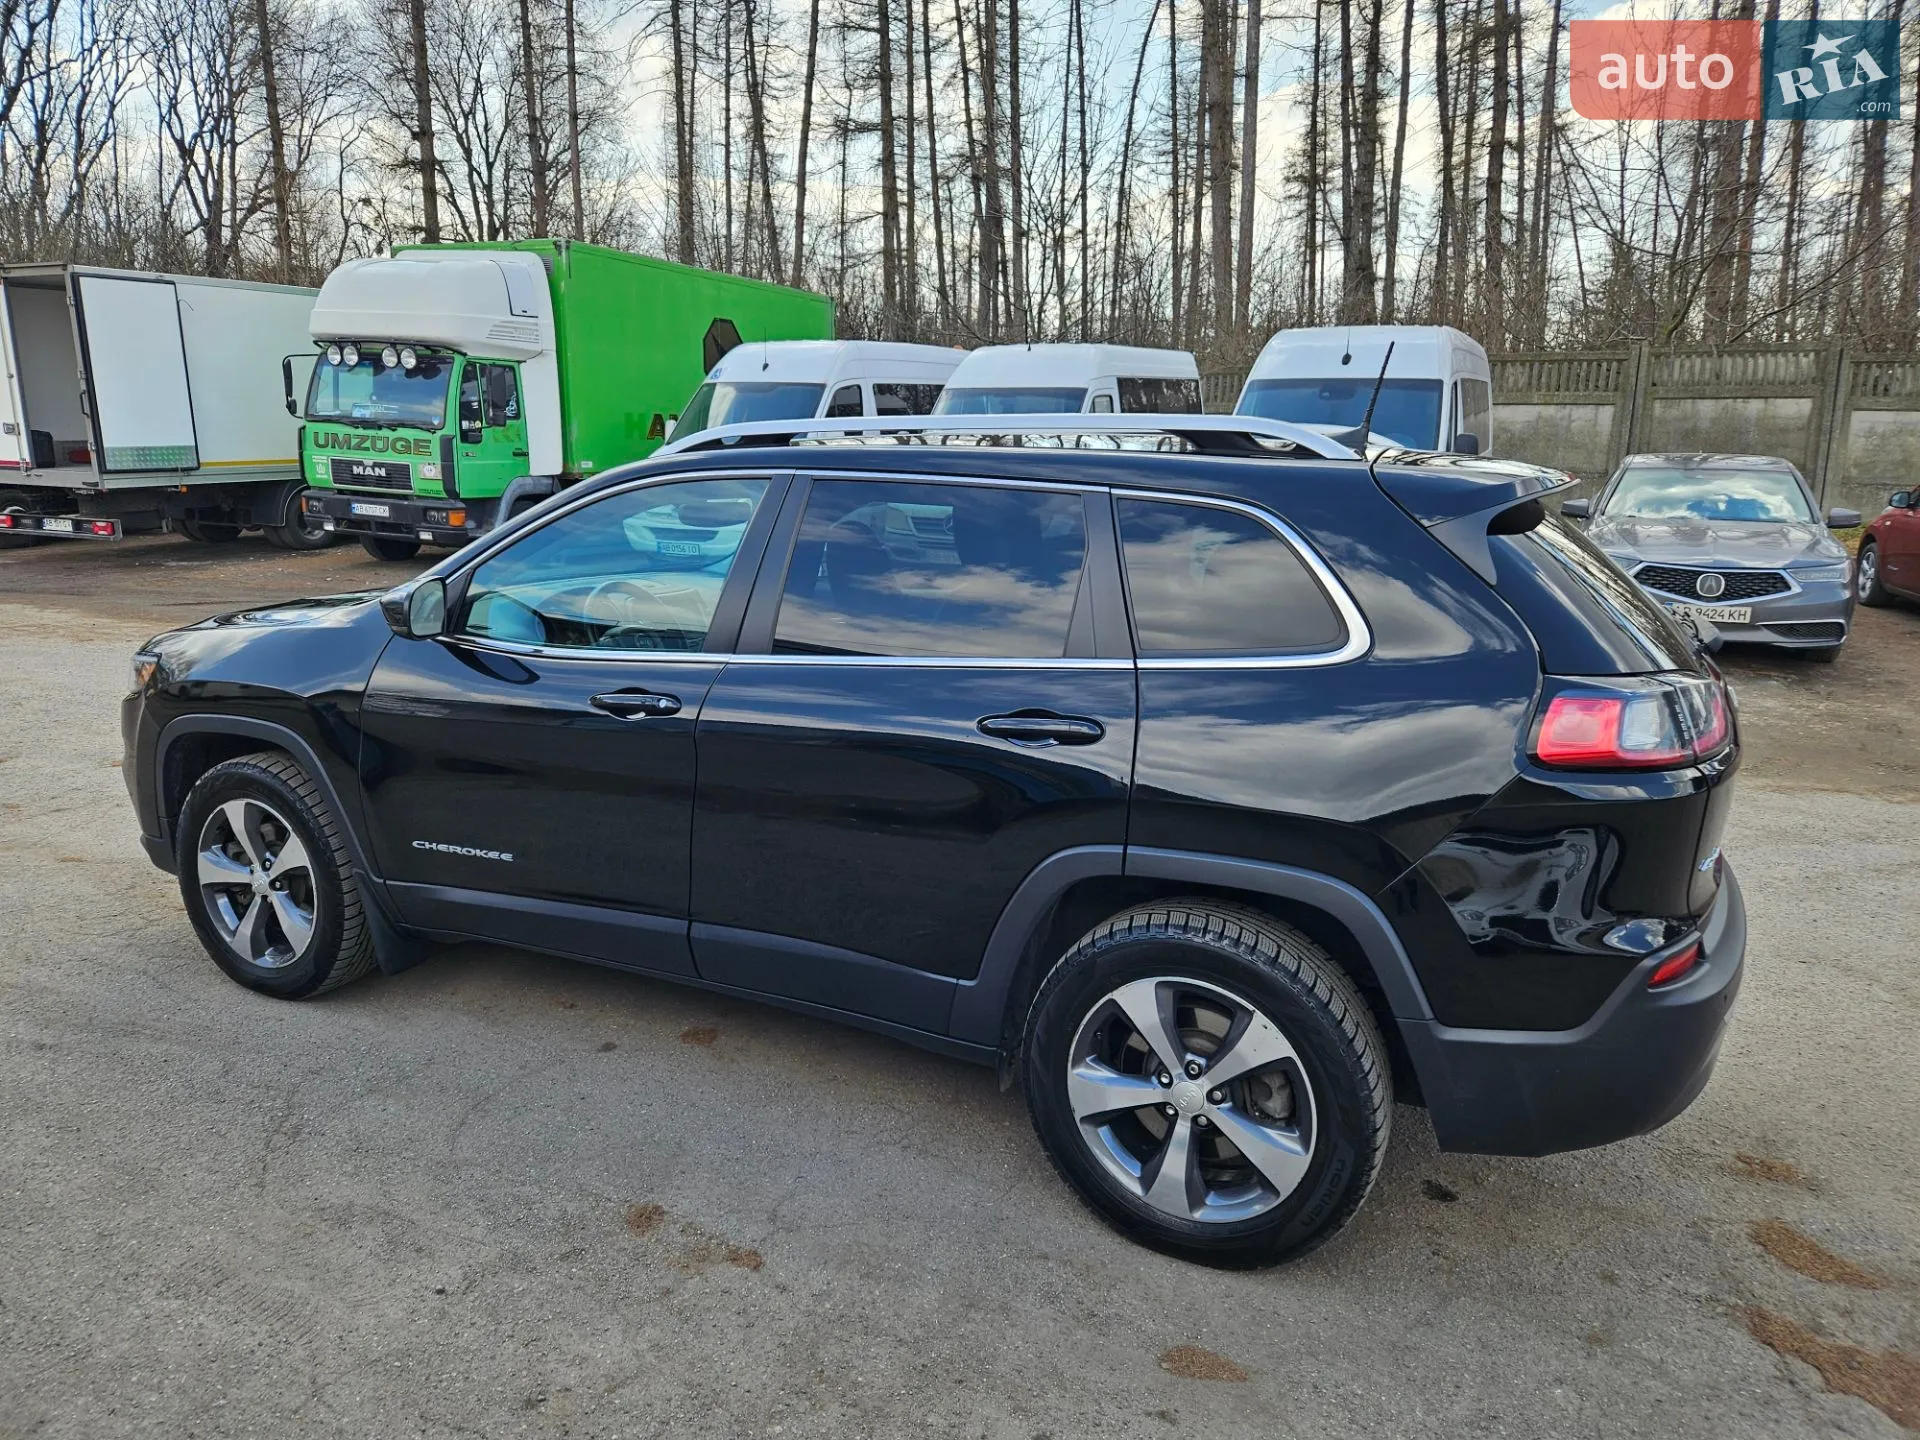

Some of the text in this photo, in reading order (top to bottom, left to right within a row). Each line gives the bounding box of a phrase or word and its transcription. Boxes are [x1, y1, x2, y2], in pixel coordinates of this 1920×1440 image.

[313, 431, 432, 456] UMZÜGE
[352, 465, 386, 477] MAN
[1695, 607, 1725, 620] 9424
[1727, 609, 1747, 621] KH
[412, 840, 514, 861] CHEROKEE
